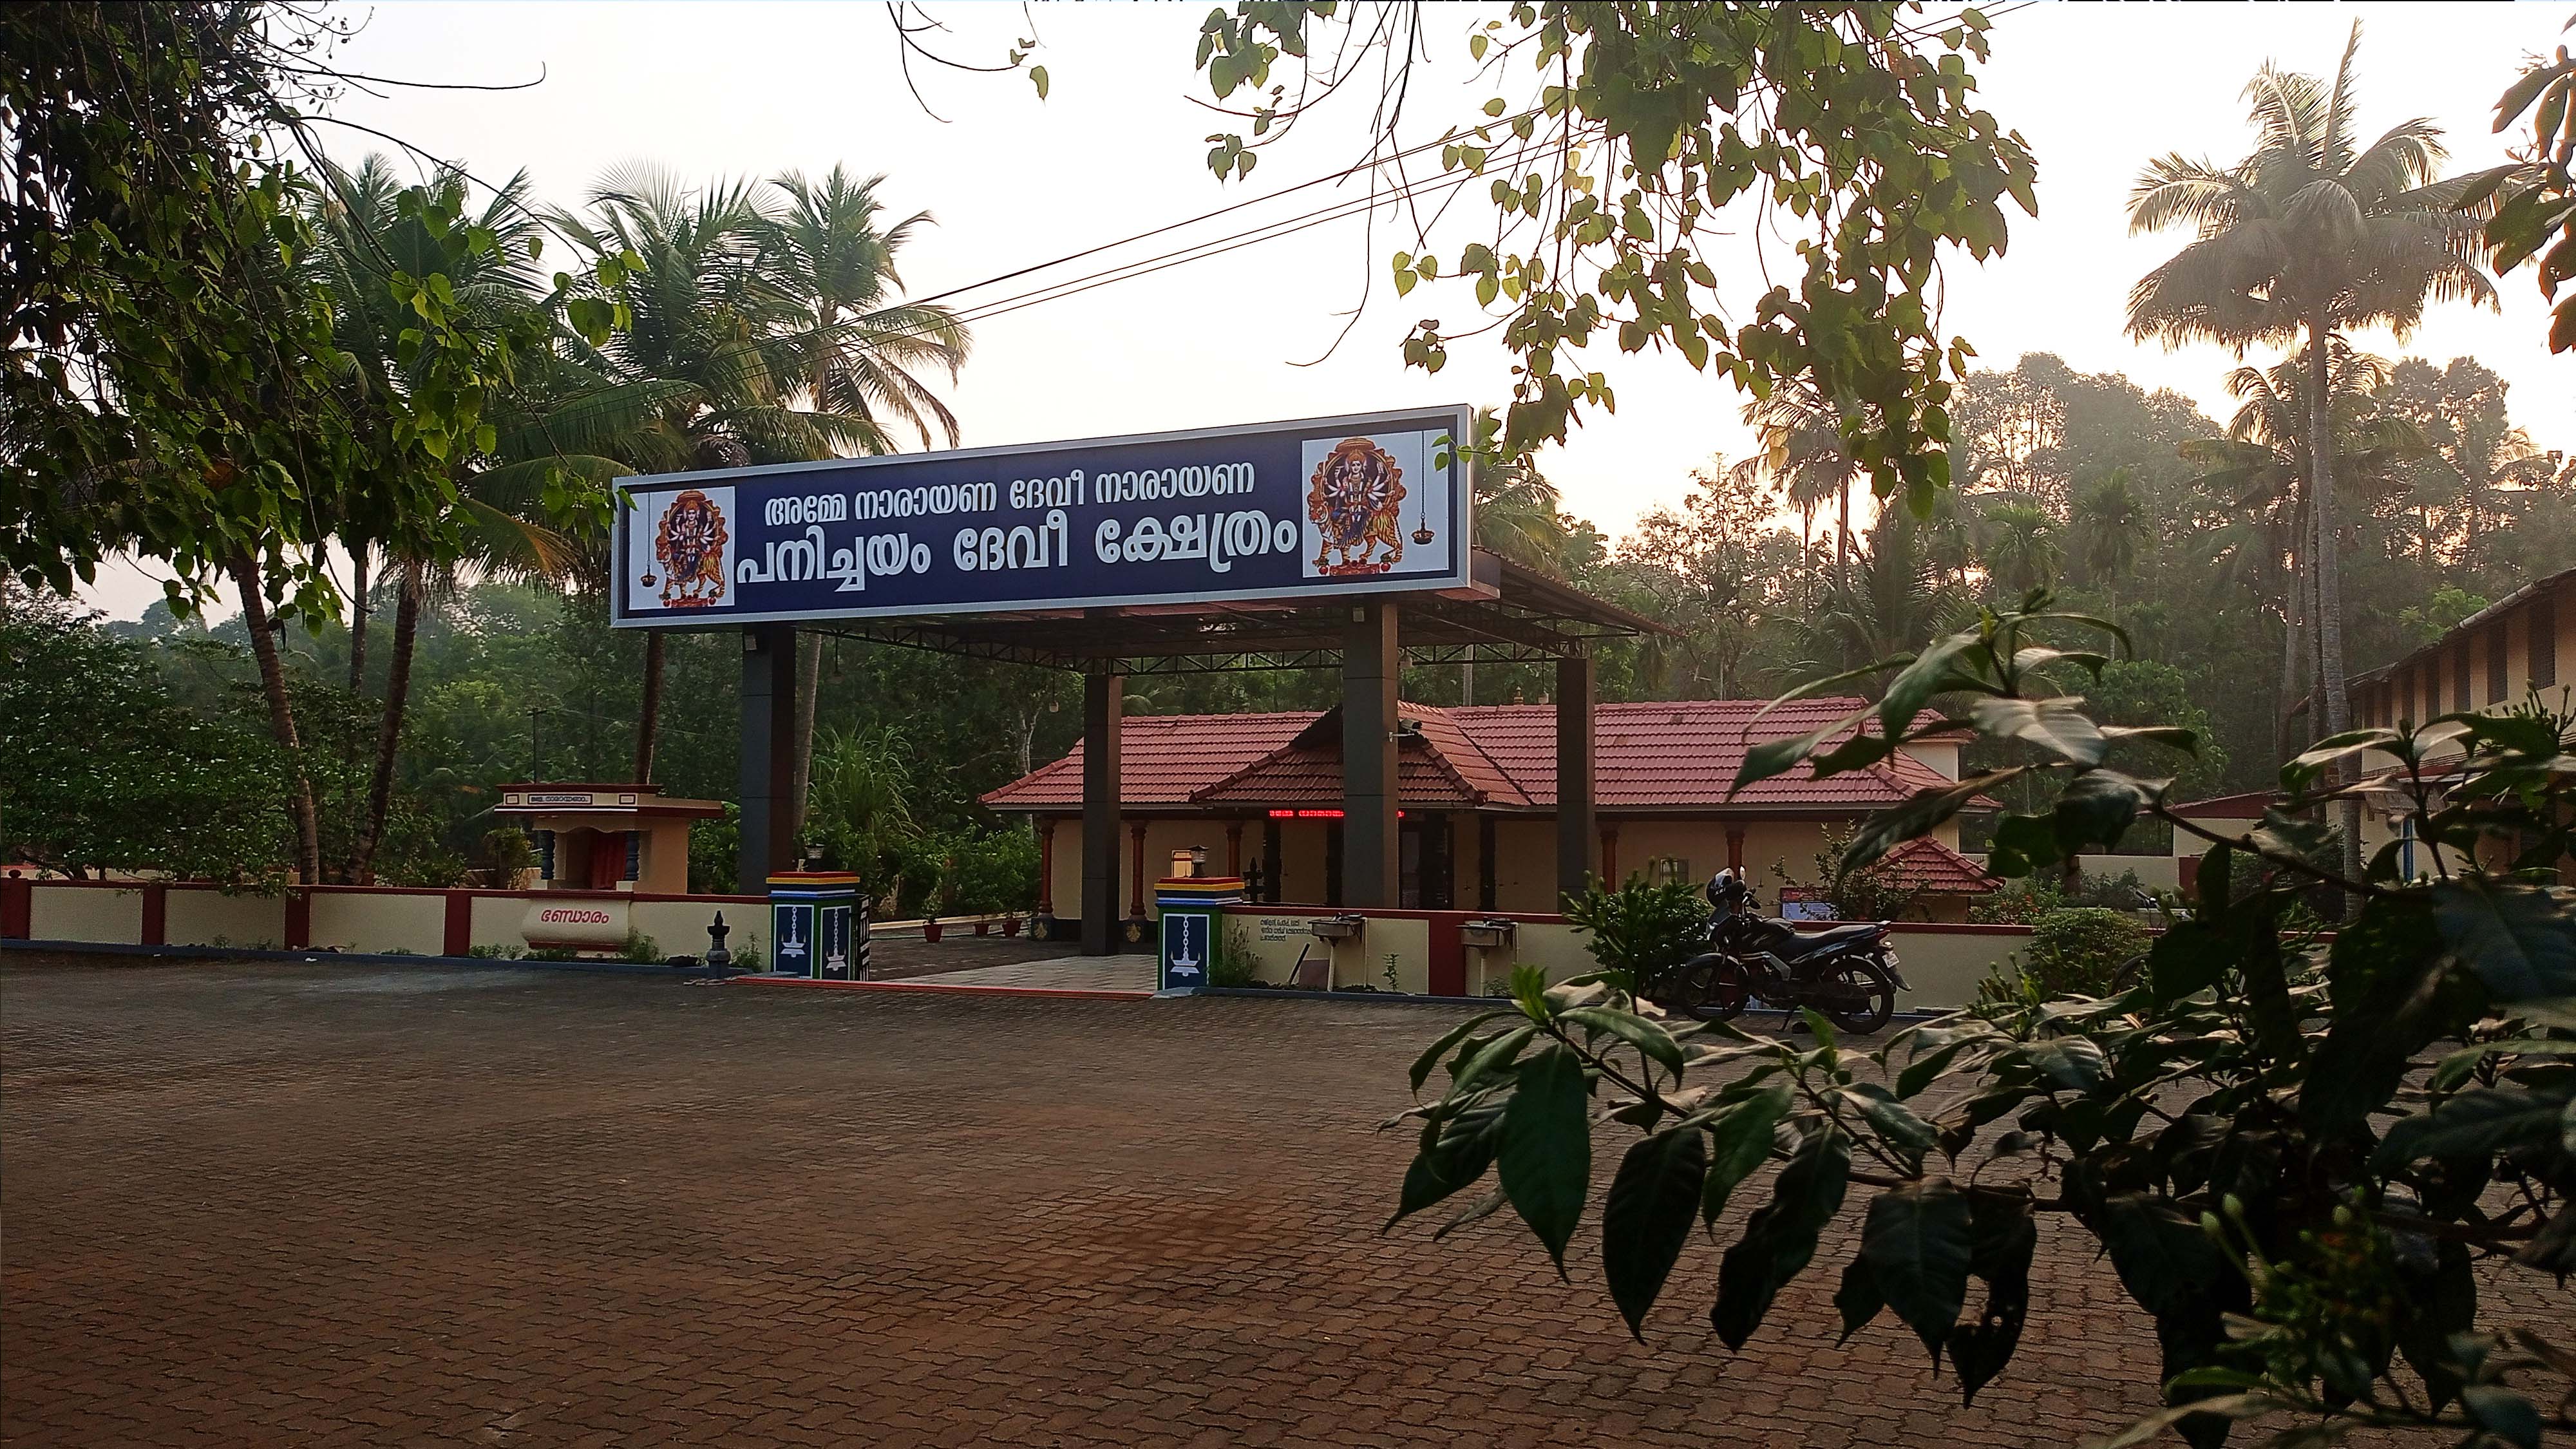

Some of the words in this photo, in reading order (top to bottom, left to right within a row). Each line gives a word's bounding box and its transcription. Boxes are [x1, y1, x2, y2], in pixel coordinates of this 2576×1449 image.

[764, 494, 848, 526] അമ്മേ
[854, 482, 998, 520] നാരായണ
[1009, 469, 1085, 509] ദേവീ
[1095, 461, 1255, 504] നാരായണ
[736, 525, 932, 592] പനിച്ചയം
[953, 509, 1068, 571] ദേവീ
[1095, 509, 1298, 573] ക്ഷേത്രം
[540, 909, 609, 924] ഭണ്ഡാരം
